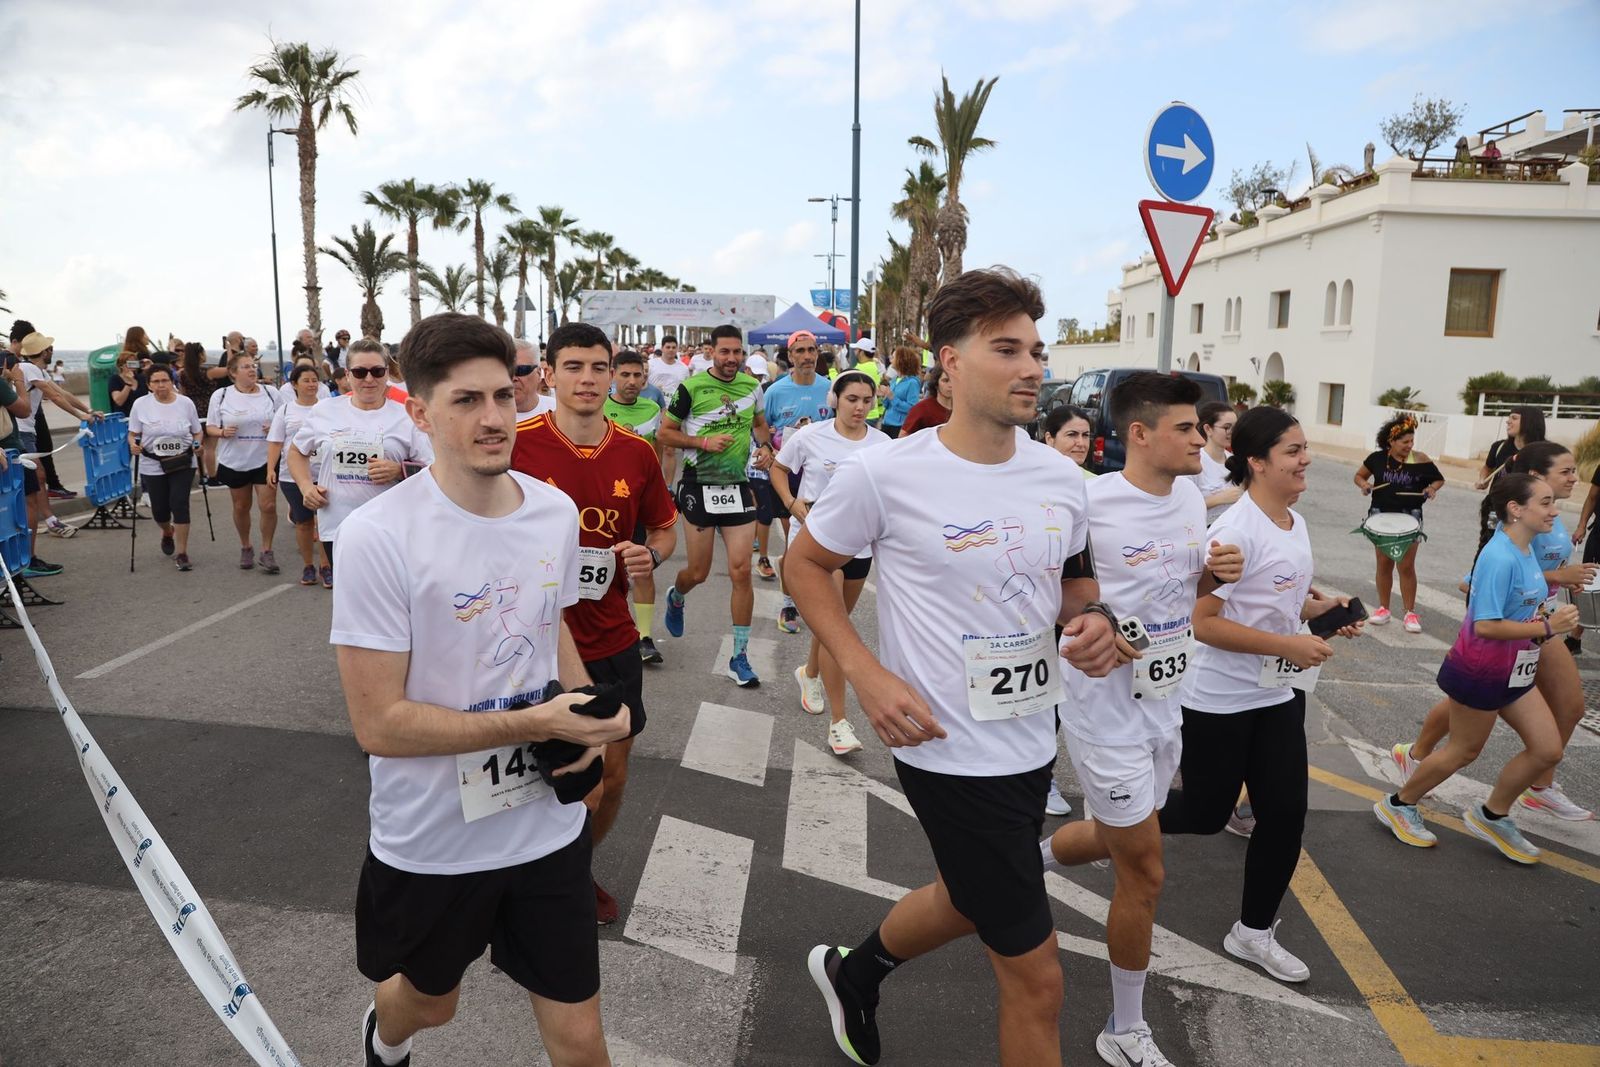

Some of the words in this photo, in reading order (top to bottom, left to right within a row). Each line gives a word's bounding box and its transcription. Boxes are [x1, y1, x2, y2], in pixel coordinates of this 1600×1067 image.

[656, 297, 699, 306] CARRERA
[701, 298, 713, 306] 5K
[156, 443, 181, 451] 1088
[711, 494, 736, 505] 964
[1003, 637, 1035, 649] CARRERA
[1149, 652, 1187, 682] 633
[990, 658, 1049, 696] 270
[499, 688, 542, 710] TRASPLANTE
